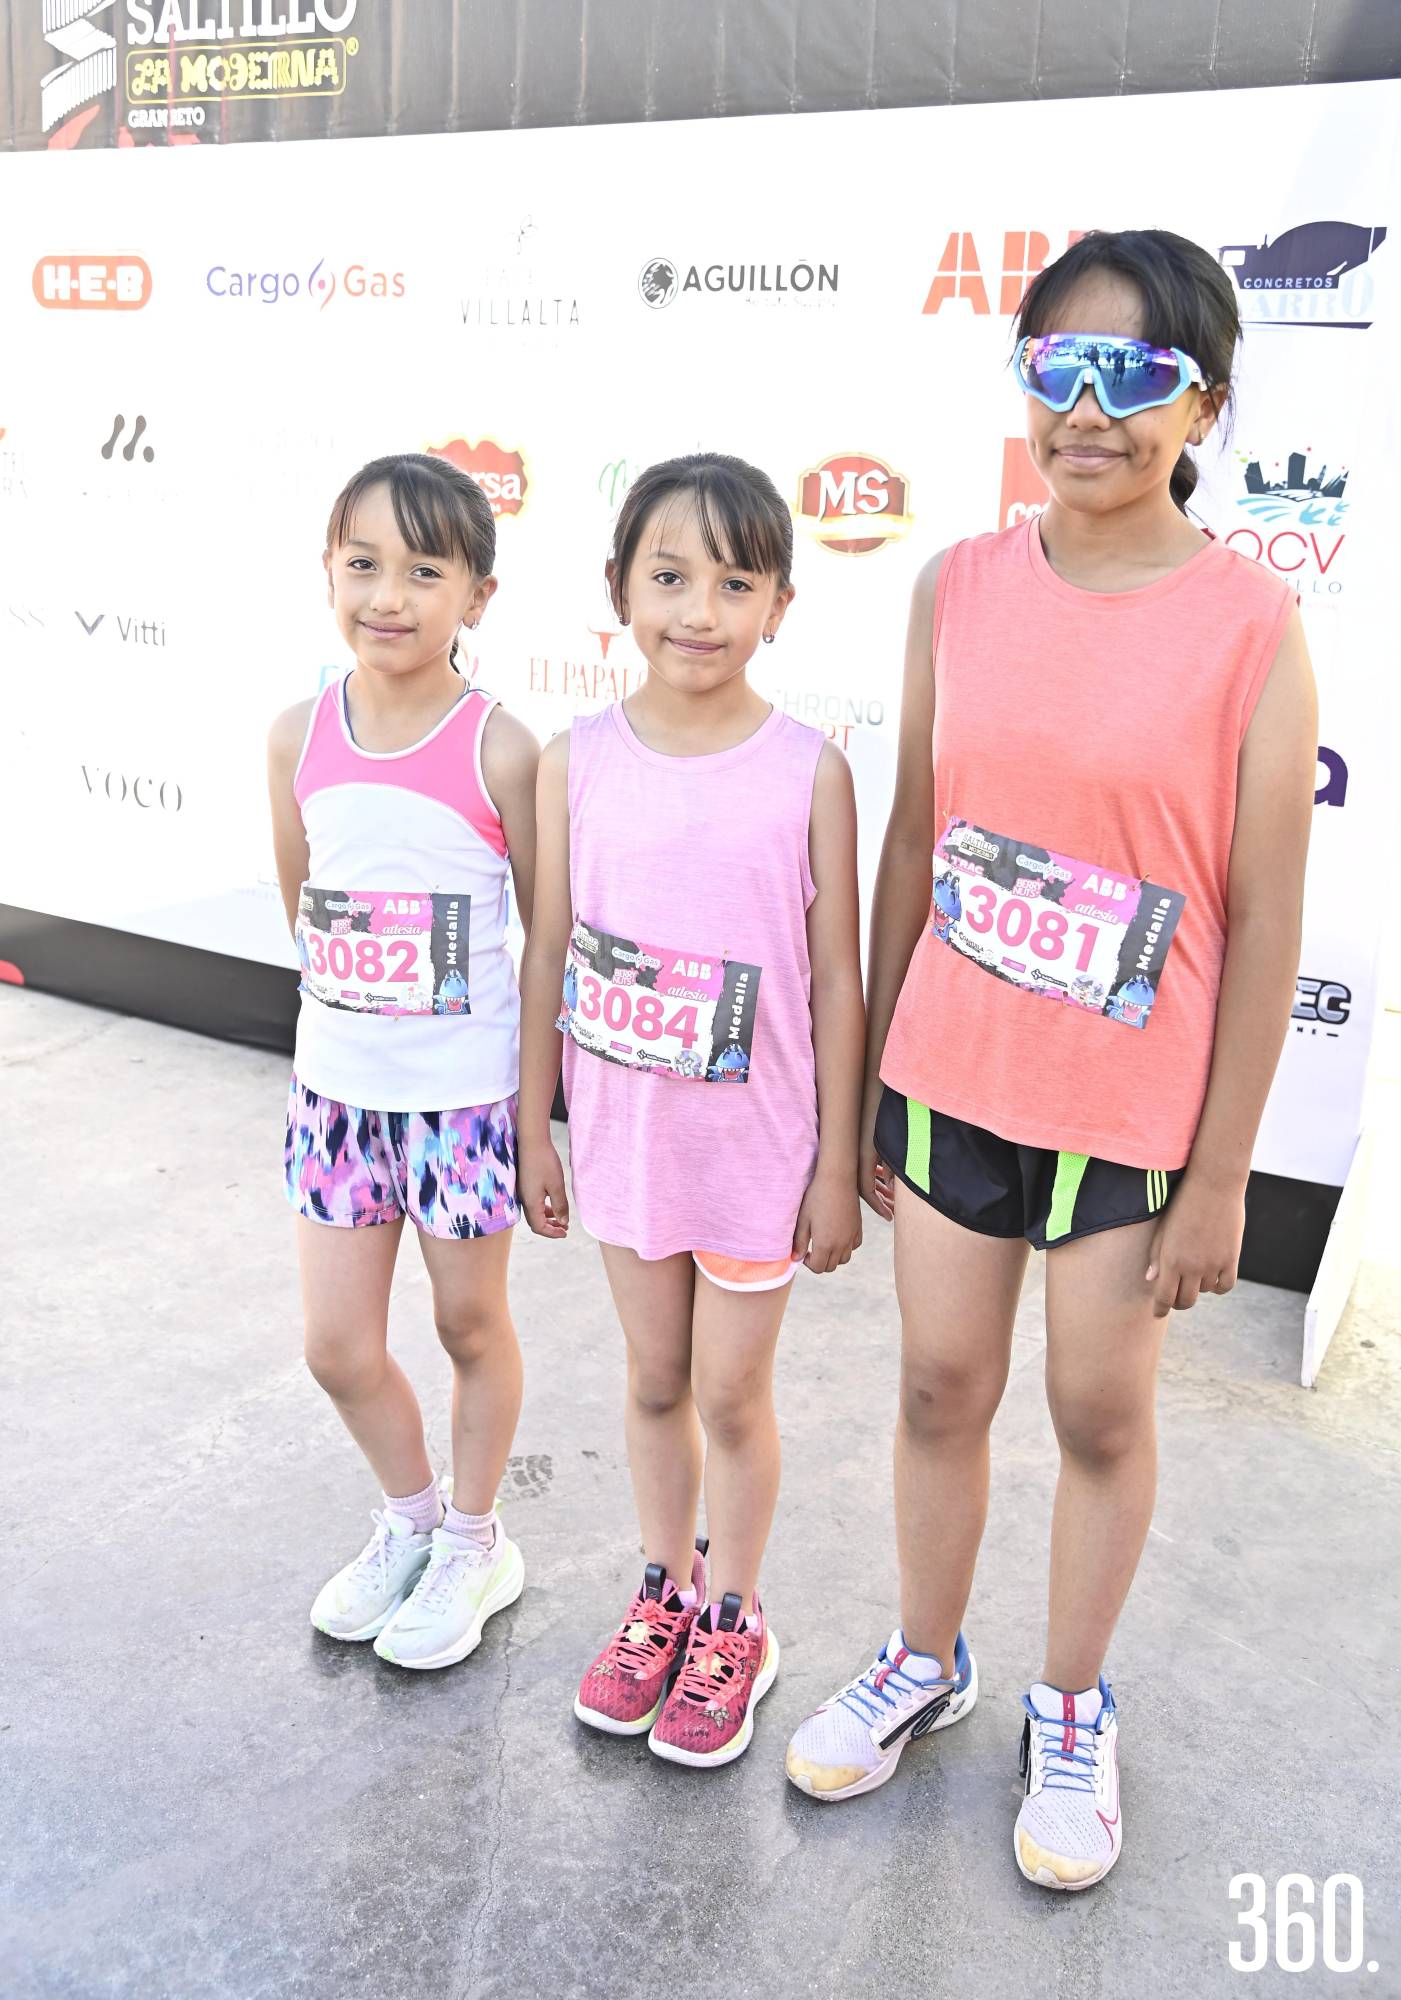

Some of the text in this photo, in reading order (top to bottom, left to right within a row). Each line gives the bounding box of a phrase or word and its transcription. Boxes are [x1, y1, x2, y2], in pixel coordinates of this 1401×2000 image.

[131, 59, 172, 96] LA
[206, 264, 407, 304] Cargo Gas
[1243, 276, 1334, 290] CONCRETOS
[459, 298, 581, 326] VILLALTA
[816, 468, 889, 526] MS
[116, 615, 168, 648] Vitti
[528, 656, 555, 694] EL
[776, 688, 885, 727] HRONO
[80, 763, 184, 813] VOCO
[1018, 855, 1070, 880] Cargo Gas
[1016, 878, 1043, 891] BERRY
[1082, 873, 1128, 902] ABB
[325, 900, 349, 912] Cargo
[383, 898, 421, 916] ABB
[1074, 901, 1120, 924] atlesia
[382, 923, 424, 937] atlesia
[446, 900, 459, 965] Medalla
[965, 885, 1100, 973] 3081
[1135, 897, 1173, 971] Medalla
[308, 933, 419, 984] 3082
[612, 947, 661, 968] Cargo Gas
[671, 959, 712, 981] ABB
[666, 984, 709, 1002] atlesia
[728, 971, 750, 1040] Medalla
[580, 975, 699, 1050] 3084
